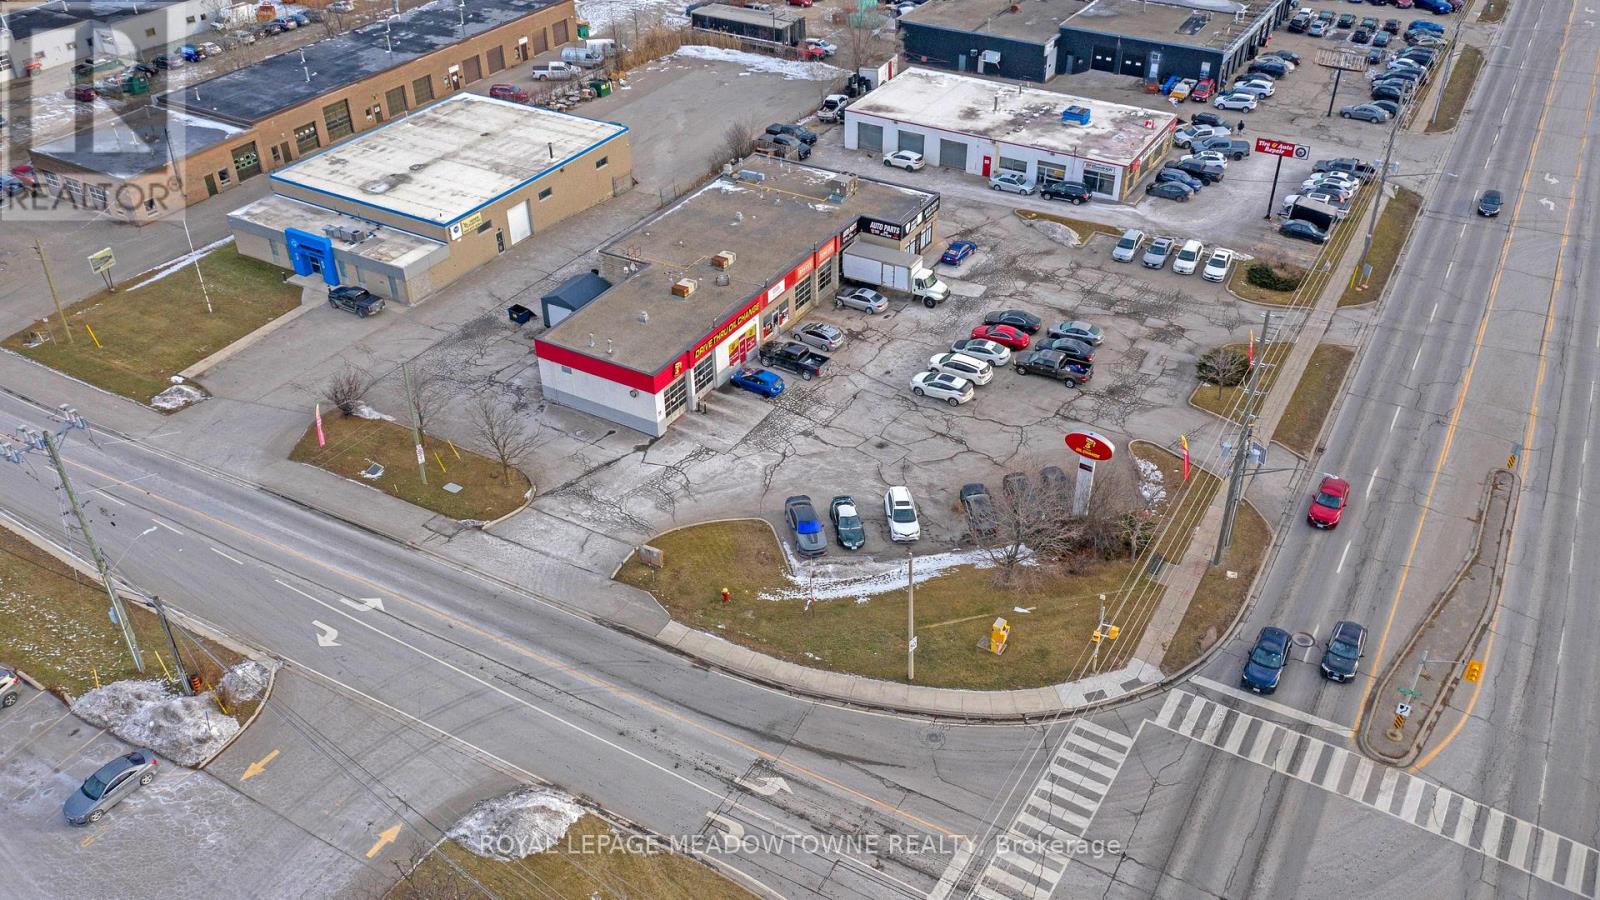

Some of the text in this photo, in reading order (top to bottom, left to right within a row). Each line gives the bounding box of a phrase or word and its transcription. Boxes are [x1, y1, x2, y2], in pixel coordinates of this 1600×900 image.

[1264, 146, 1285, 154] Repair
[1278, 143, 1293, 151] Auto
[869, 221, 883, 230] AUTO
[883, 223, 900, 233] PARTS
[695, 338, 713, 358] DRIVE
[713, 326, 728, 344] THRU
[736, 302, 760, 325] CHANGE
